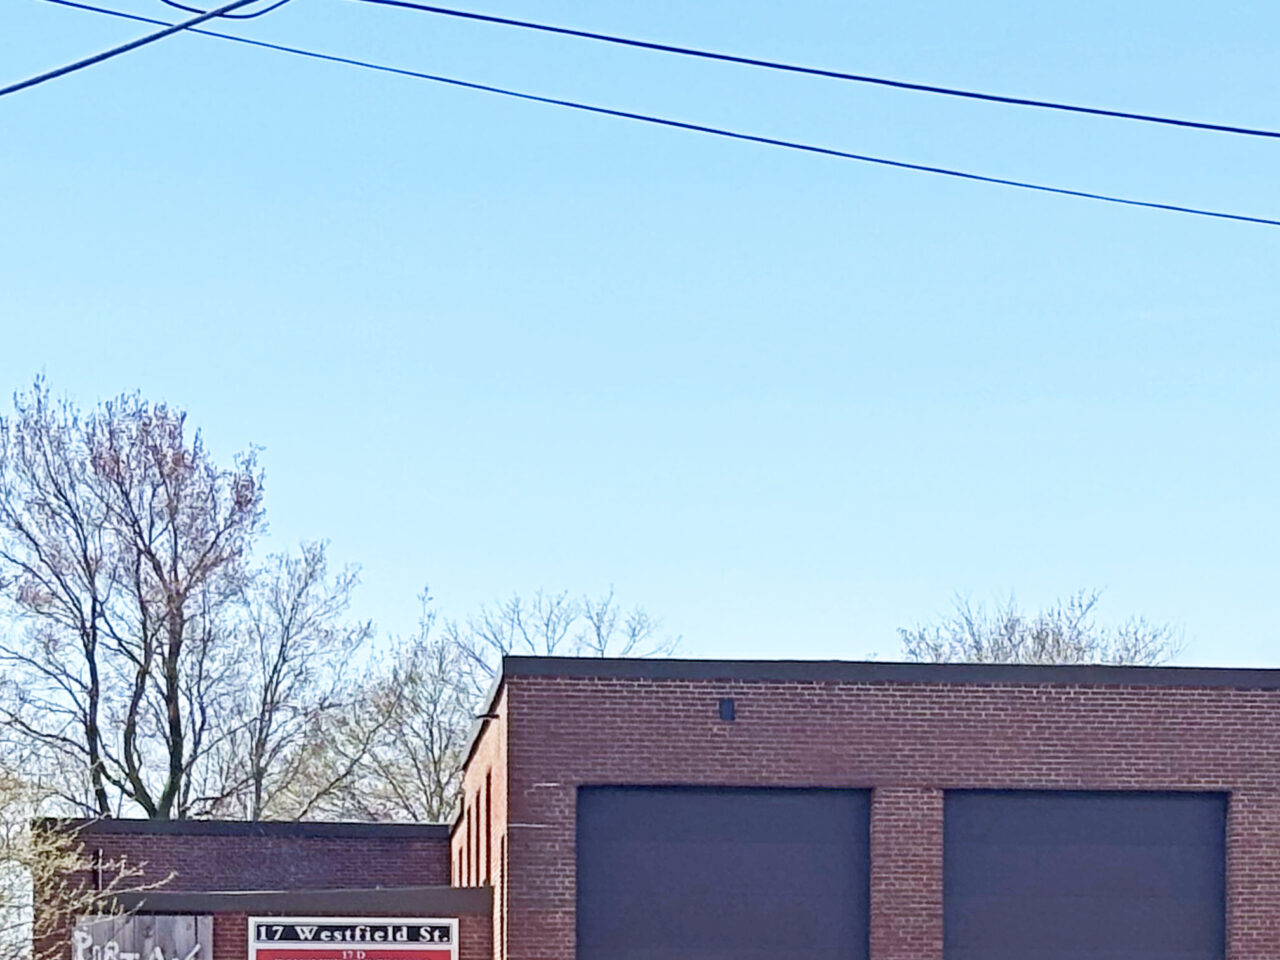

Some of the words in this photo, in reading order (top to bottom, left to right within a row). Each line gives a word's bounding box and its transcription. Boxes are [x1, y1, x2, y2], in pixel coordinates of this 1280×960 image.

[258, 926, 284, 941] 17
[295, 925, 408, 942] Westfield
[419, 926, 449, 942] St.
